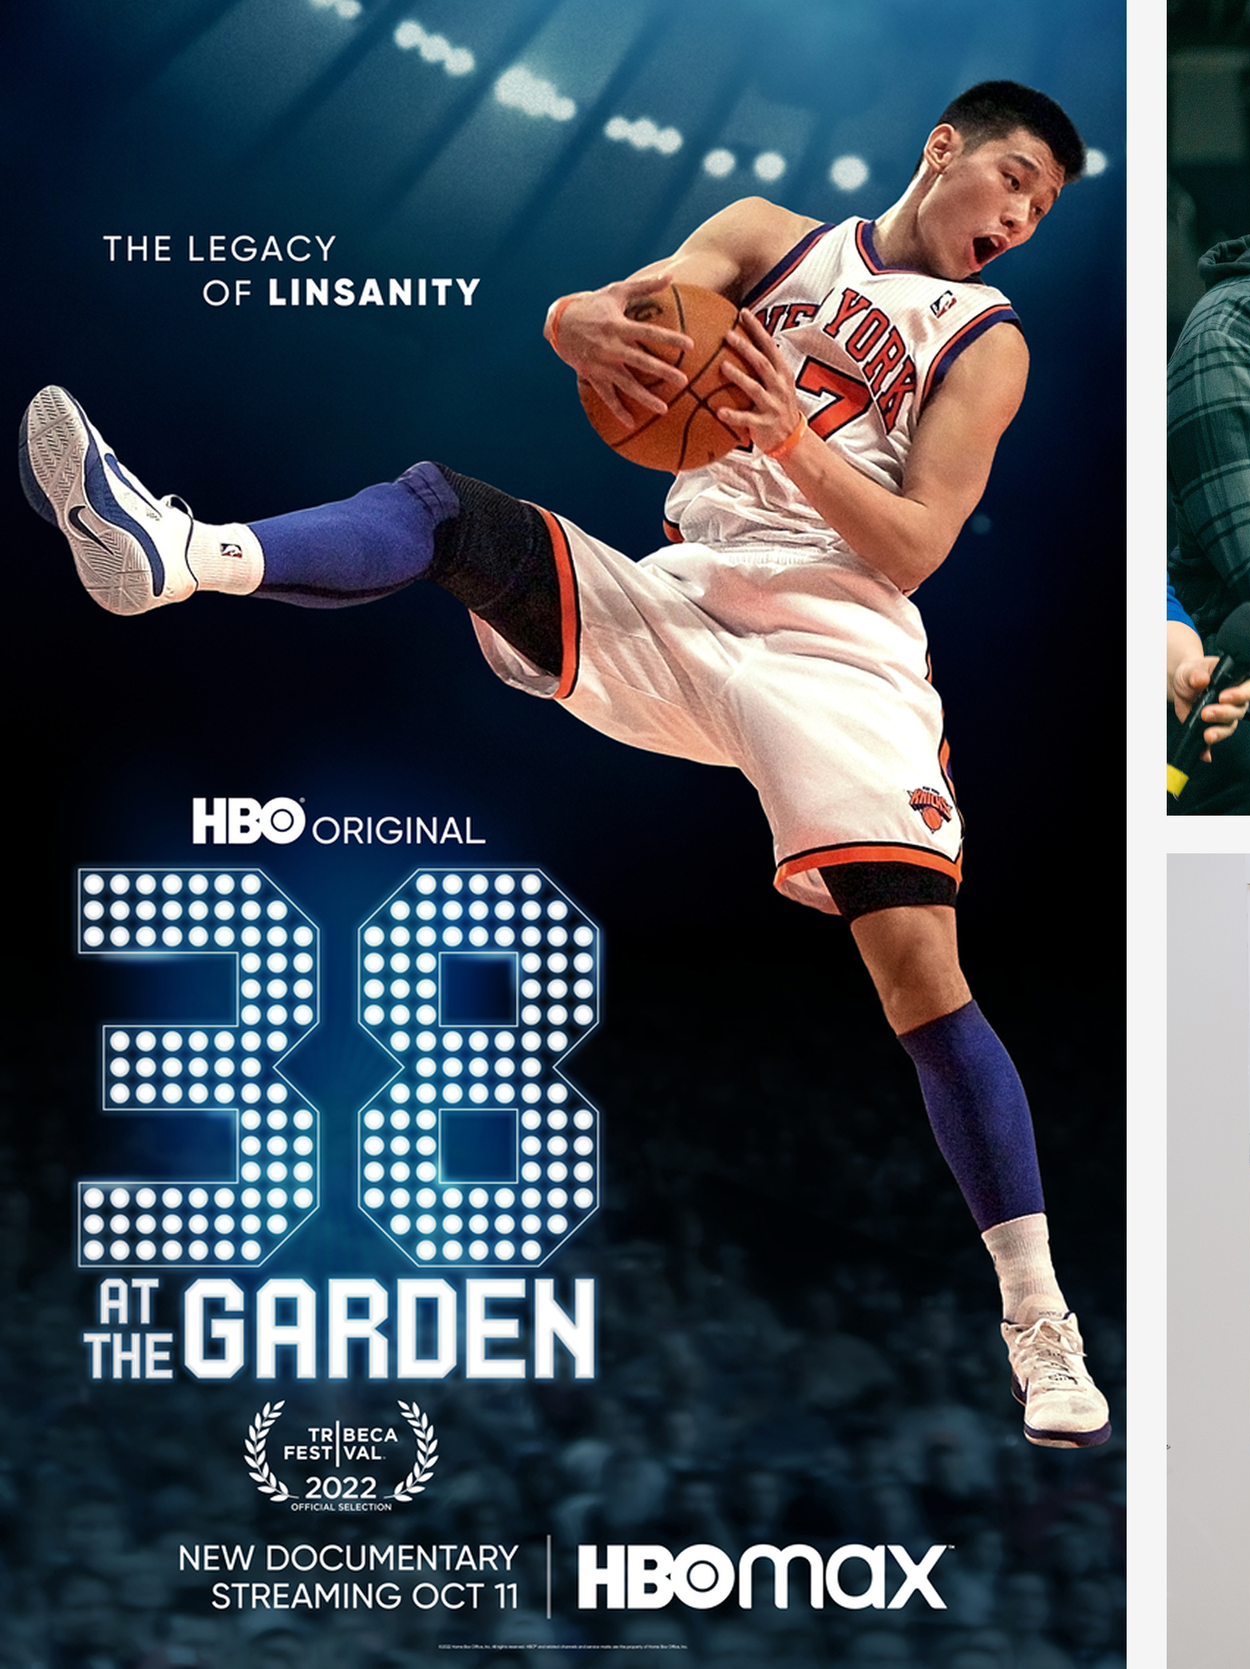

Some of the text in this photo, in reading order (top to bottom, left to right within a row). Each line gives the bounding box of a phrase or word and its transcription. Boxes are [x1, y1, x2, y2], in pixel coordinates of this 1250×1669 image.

[103, 235, 336, 262] THE LEGACY
[203, 278, 481, 307] OF LINSANITY
[823, 287, 917, 436] YORK
[312, 817, 486, 845] ORIGINAL
[78, 868, 600, 1268] 38
[100, 1279, 160, 1324] AT
[84, 1279, 595, 1378] THE GARDEN
[305, 1477, 377, 1499] 2022
[291, 1503, 392, 1511] OFFICIAL SELECTION
[179, 1545, 519, 1571] NEW DOCUMENTARY
[211, 1583, 518, 1609] STREAMING OCT 11
